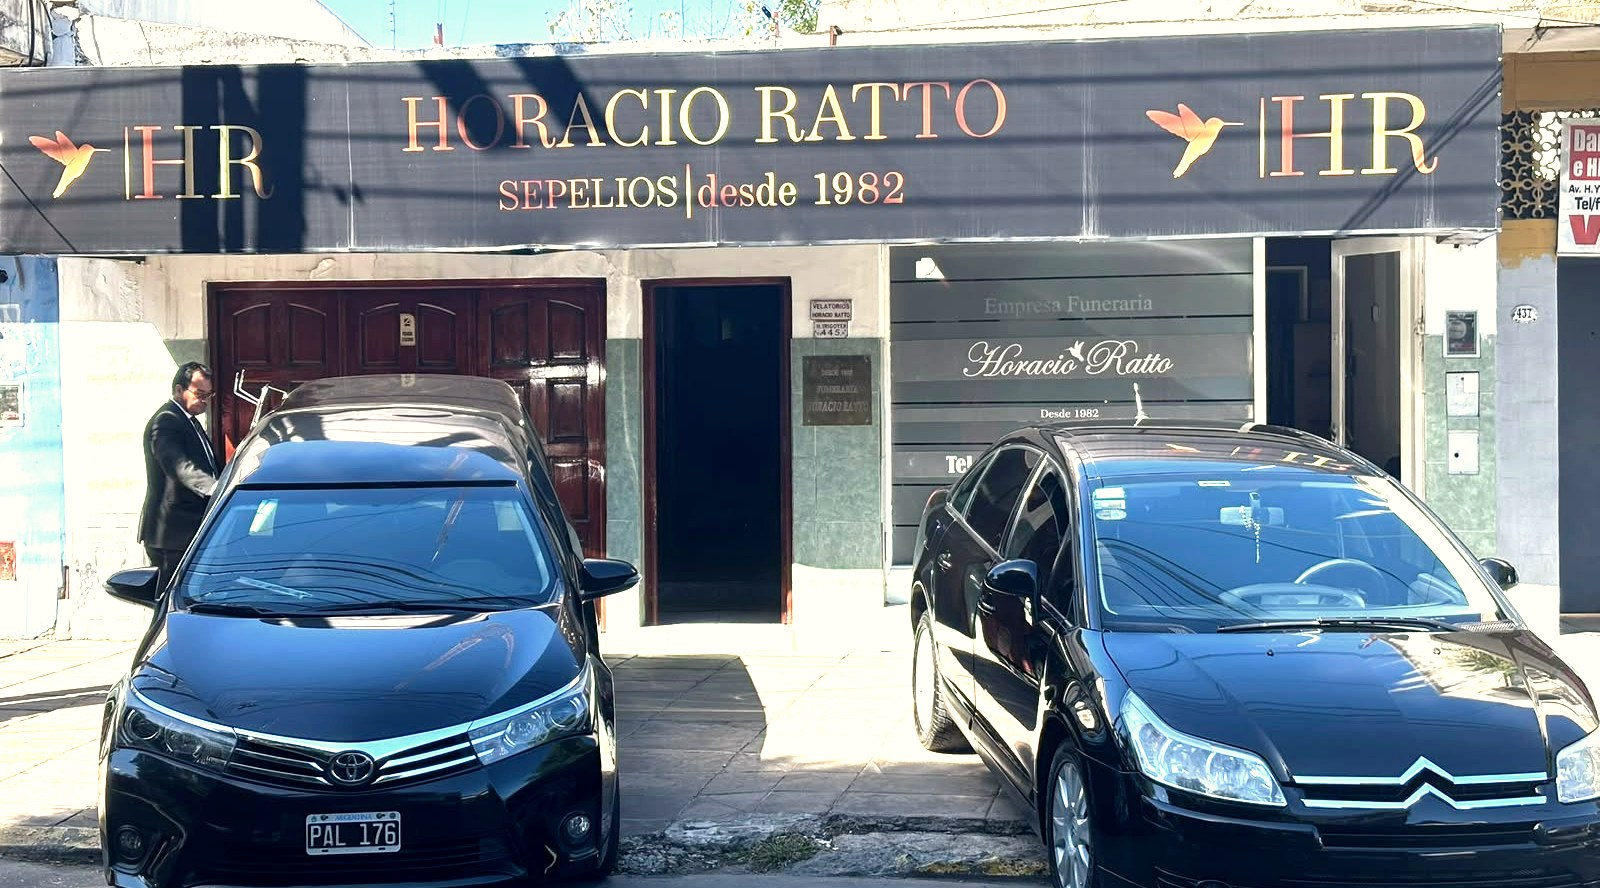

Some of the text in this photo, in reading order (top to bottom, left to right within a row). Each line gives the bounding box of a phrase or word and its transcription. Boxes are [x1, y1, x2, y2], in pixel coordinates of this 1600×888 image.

[401, 78, 1008, 154] HORACIO RATTO
[1268, 91, 1439, 177] HR
[1574, 129, 1600, 152] Da
[133, 124, 275, 200] HR
[1573, 157, 1600, 177] e H
[498, 170, 906, 211] SEPELIOS desde 1982
[1568, 184, 1582, 194] Av.
[983, 293, 1154, 316] Empresa Funeraria
[1516, 308, 1532, 319] 437
[962, 339, 1175, 378] Horacio Ratto
[1040, 408, 1100, 419] Desde 1982
[310, 822, 397, 847] PAL 176
